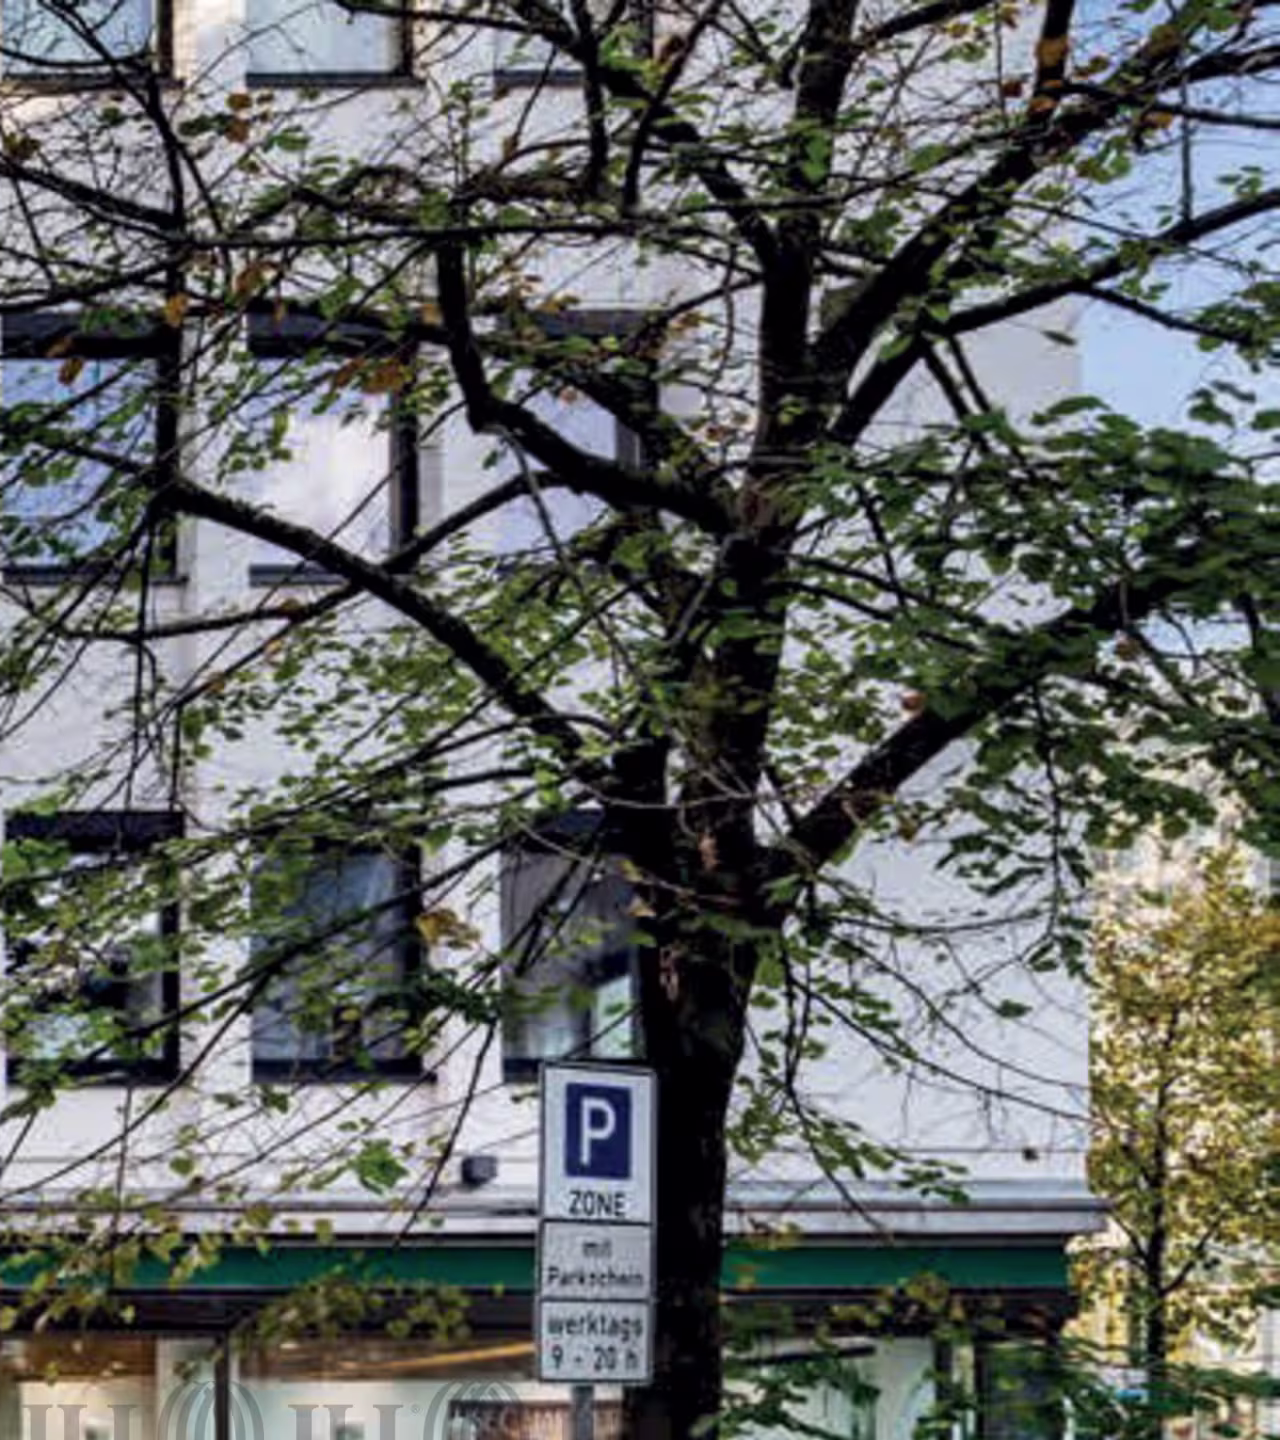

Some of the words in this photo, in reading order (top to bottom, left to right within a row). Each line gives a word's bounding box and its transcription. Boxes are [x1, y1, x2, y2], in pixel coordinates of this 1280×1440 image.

[580, 1097, 617, 1166] P
[568, 1189, 627, 1217] ZONE
[582, 1238, 613, 1259] mit
[547, 1265, 644, 1288] Parkschein
[547, 1311, 643, 1343] werktags
[551, 1343, 564, 1371] 9
[593, 1344, 617, 1372] 20
[624, 1346, 639, 1370] h
